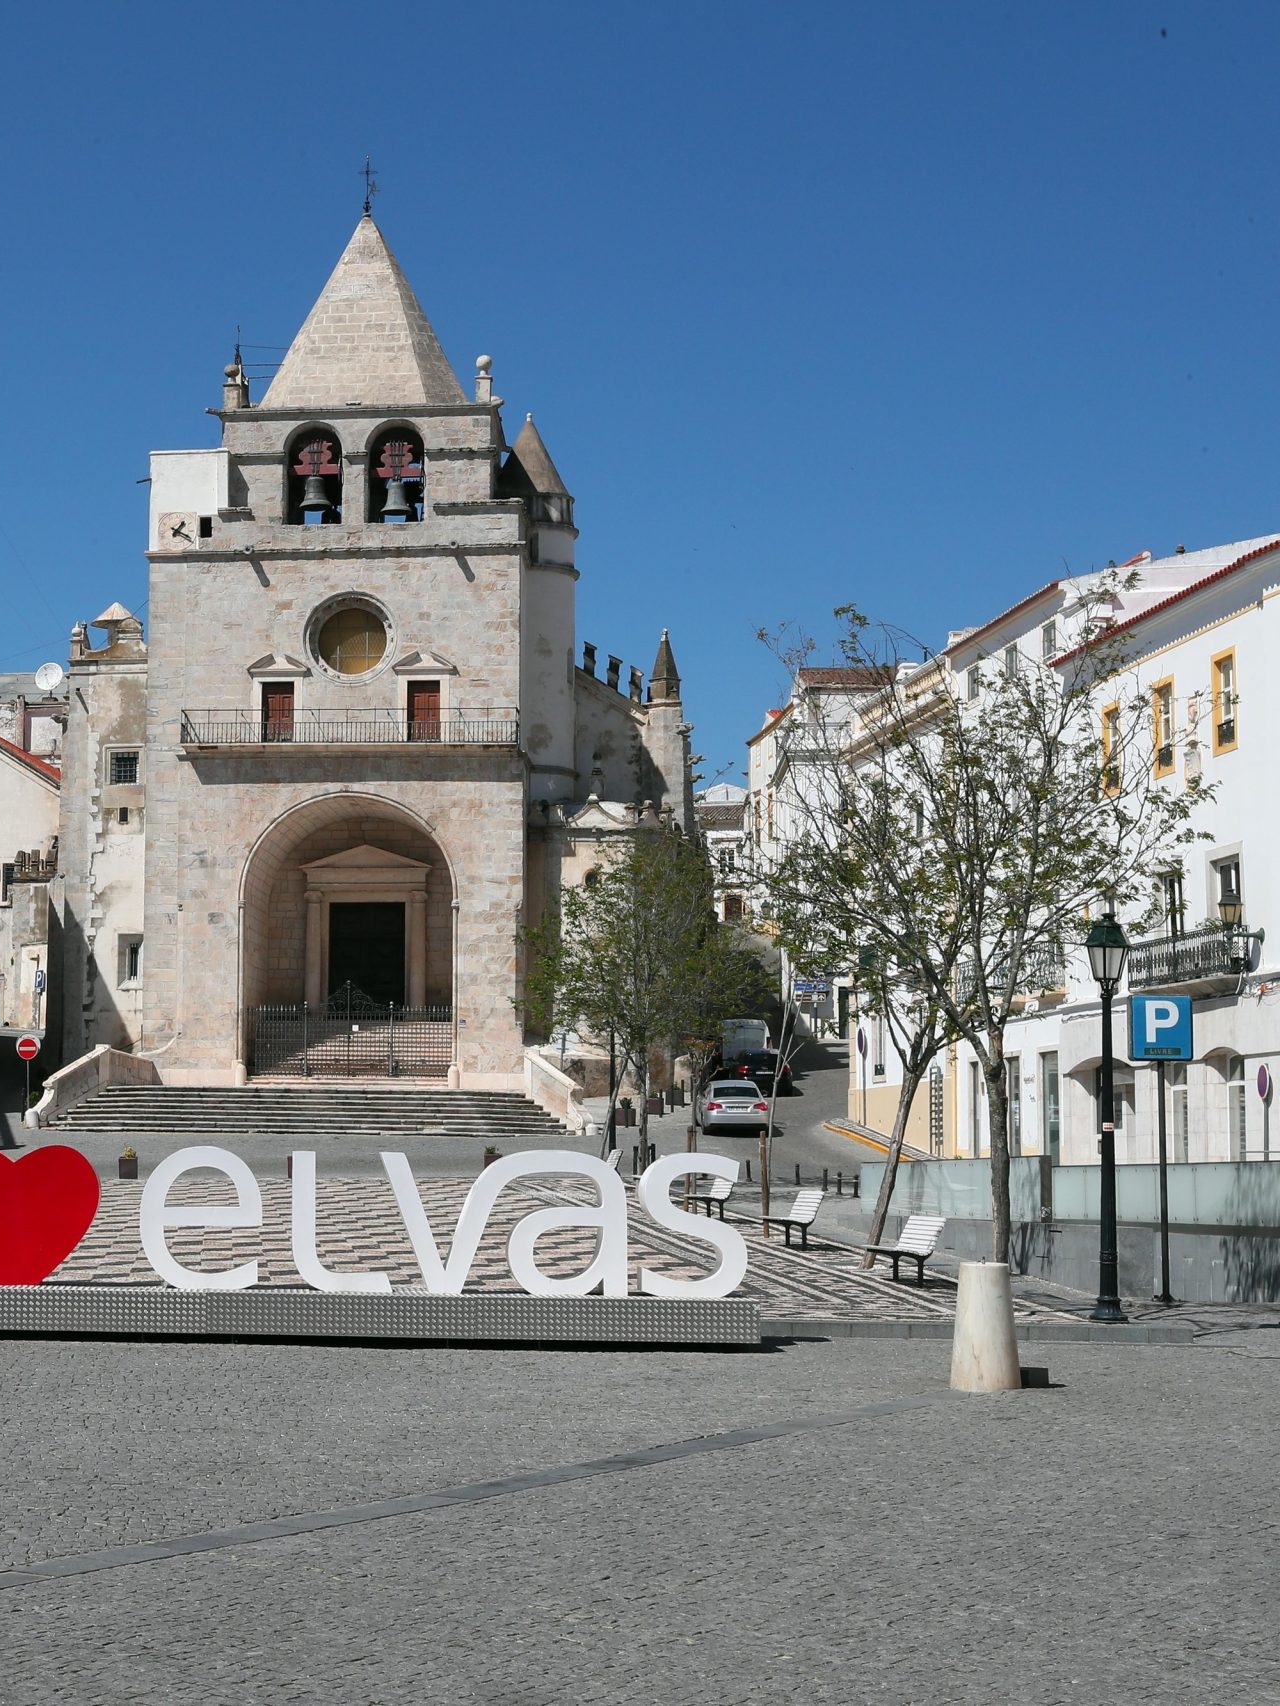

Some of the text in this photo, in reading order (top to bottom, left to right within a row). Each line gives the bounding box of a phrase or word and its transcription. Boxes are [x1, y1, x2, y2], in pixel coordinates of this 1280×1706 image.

[36, 972, 42, 987] P
[1145, 1000, 1179, 1043] P
[140, 1146, 748, 1299] elvas
